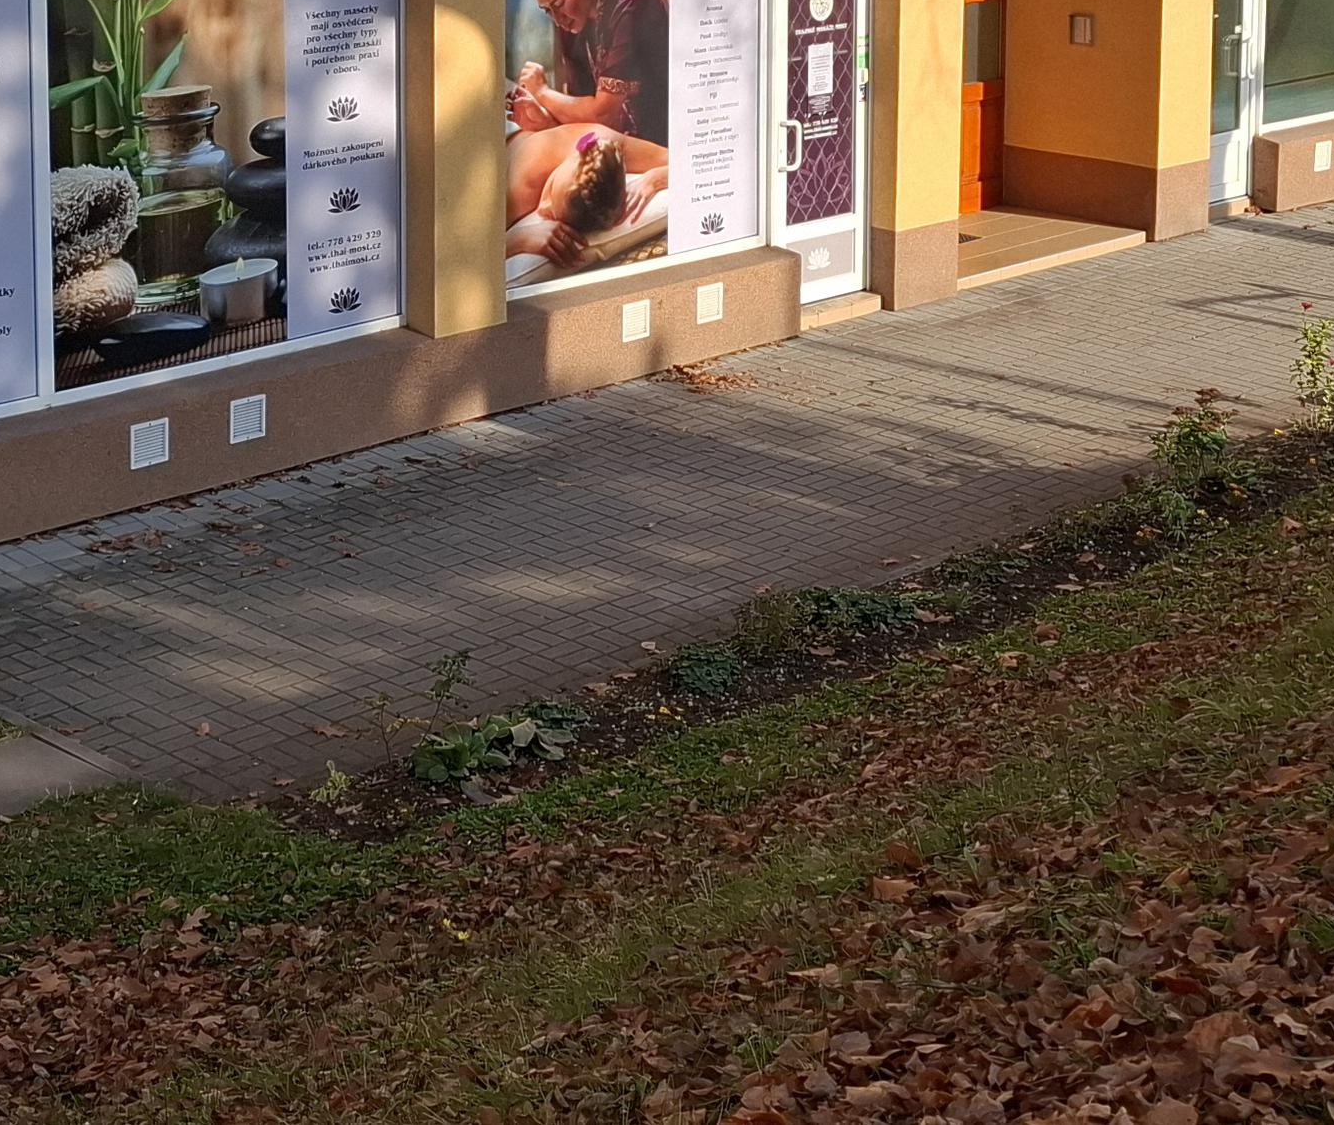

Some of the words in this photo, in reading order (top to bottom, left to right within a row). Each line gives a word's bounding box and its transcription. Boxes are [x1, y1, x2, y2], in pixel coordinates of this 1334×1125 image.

[305, 9, 341, 21] Všechny
[343, 5, 379, 15] masérky
[311, 21, 329, 32] mají
[306, 35, 321, 45] pro
[324, 29, 358, 43] všechny
[360, 28, 378, 38] typy
[303, 43, 350, 55] nabízených
[312, 54, 356, 67] potřebnou
[333, 65, 361, 74] oboru.
[303, 145, 338, 159] Možnost
[342, 140, 384, 156] zakoupení
[303, 156, 347, 171] dárkového
[350, 151, 385, 166] poukazu
[327, 237, 343, 247] 778
[346, 233, 362, 244] 429
[365, 229, 381, 241] 329
[309, 253, 380, 274] www.thaimost.cz
